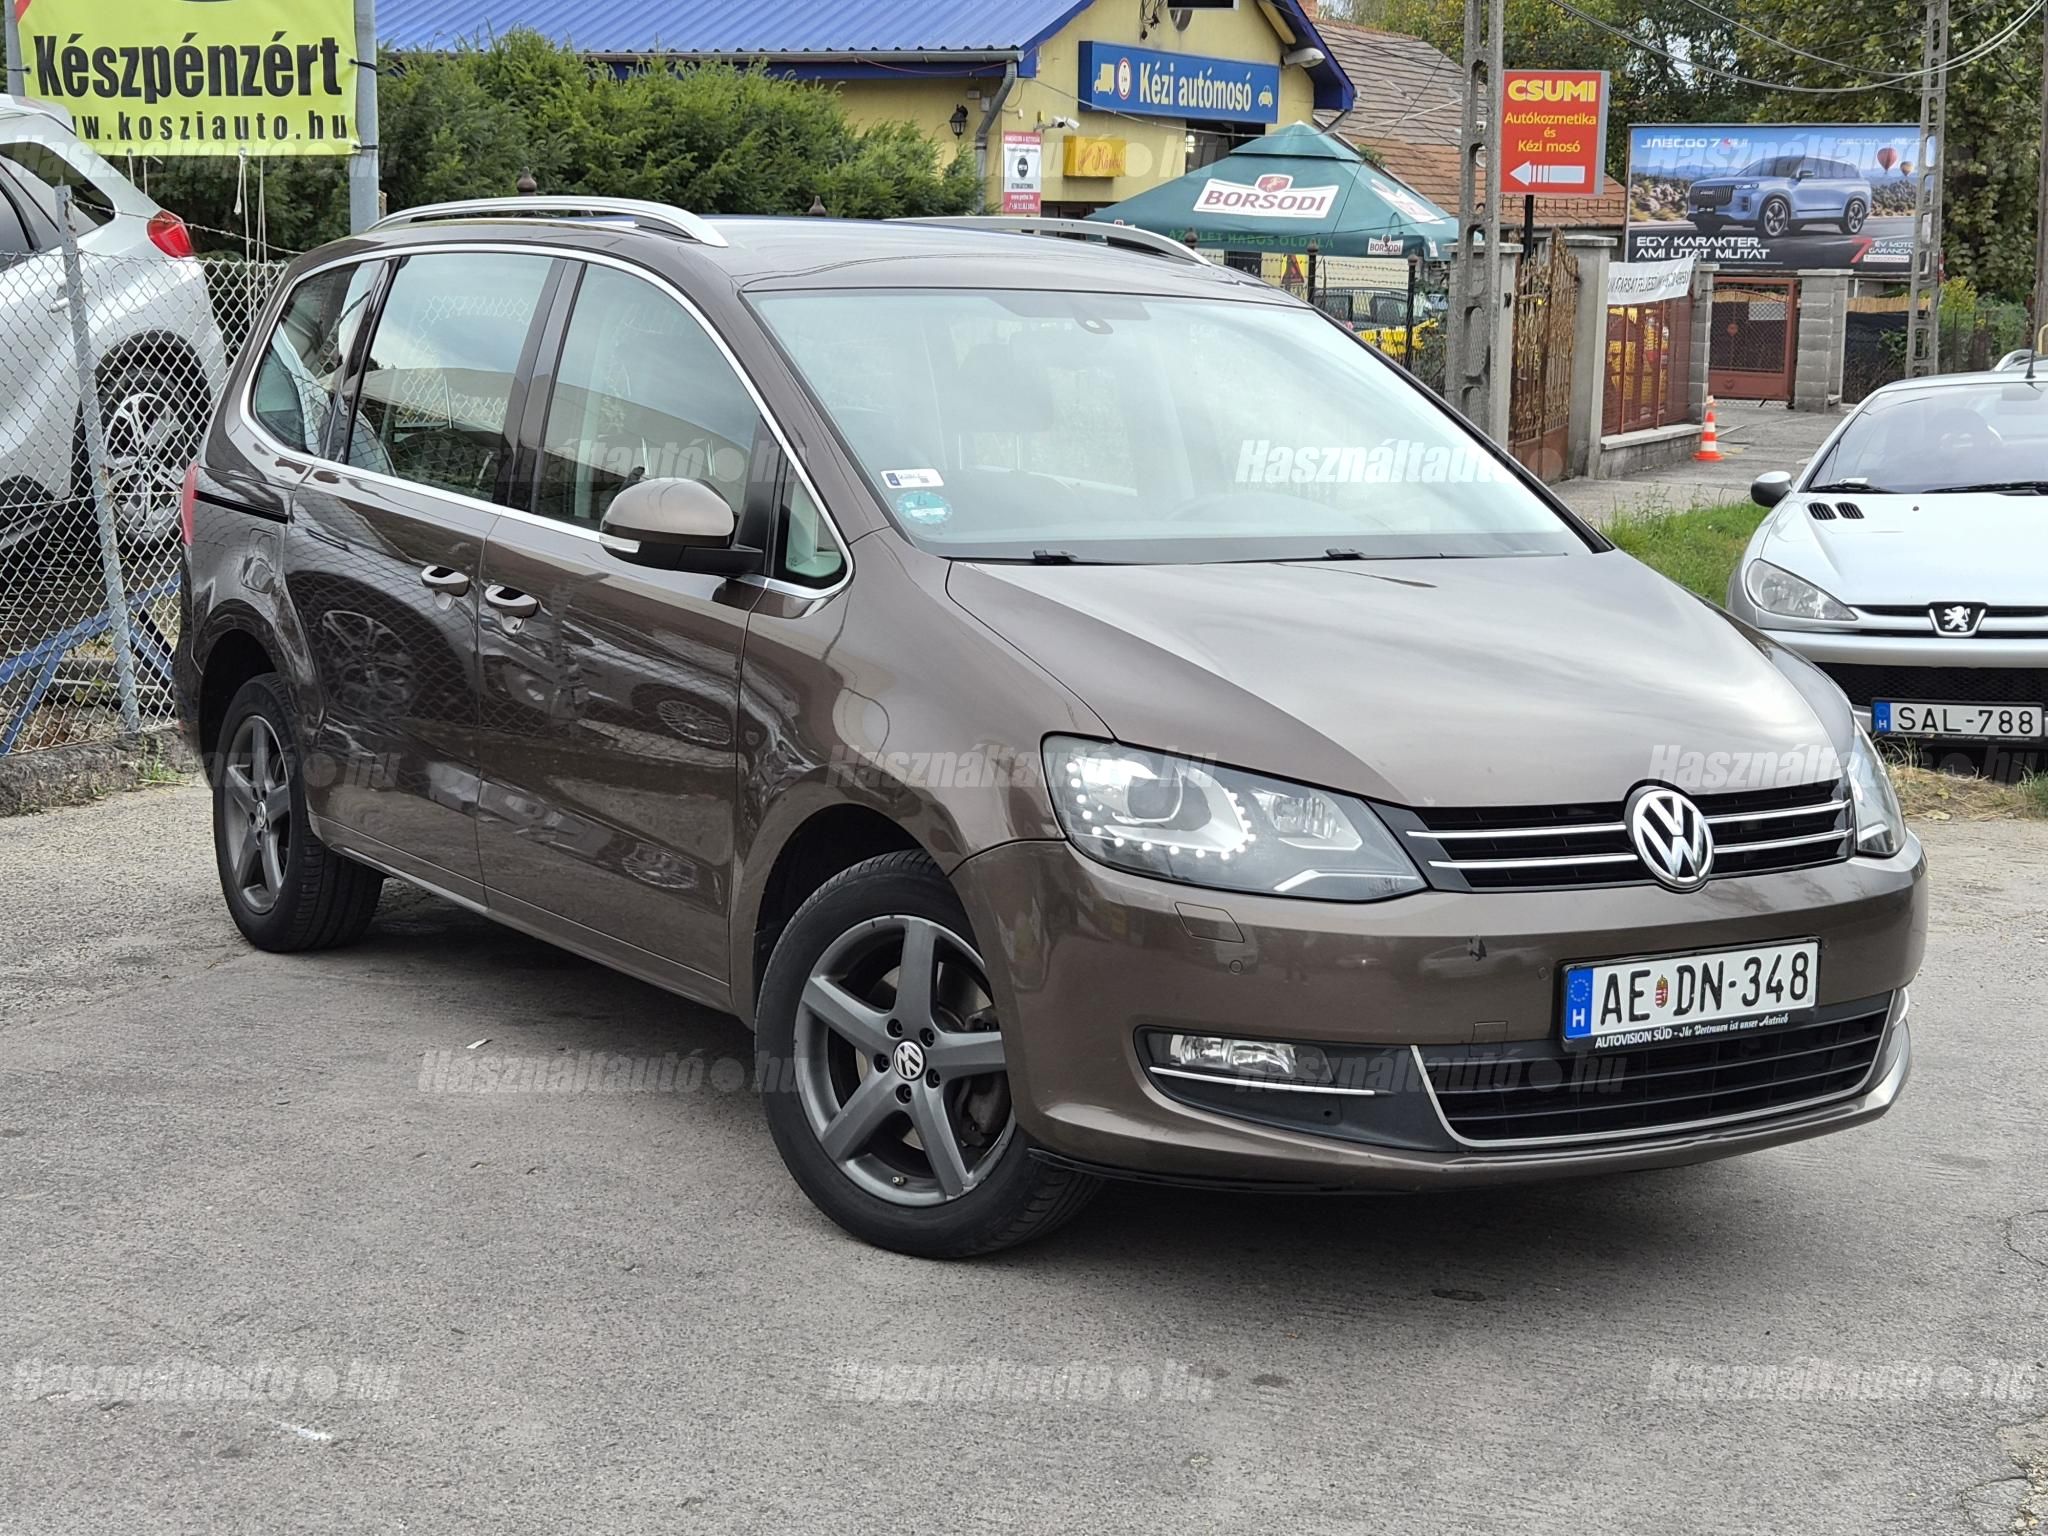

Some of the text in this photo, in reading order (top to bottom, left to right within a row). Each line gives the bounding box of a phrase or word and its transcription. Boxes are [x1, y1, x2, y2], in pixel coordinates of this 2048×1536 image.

[33, 31, 343, 104] Készpénzért
[1139, 60, 1251, 112] Kézi autómosó
[1507, 79, 1597, 102] CSUMI
[1504, 111, 1597, 125] Autókozmetika
[1543, 127, 1557, 138] és
[1518, 139, 1581, 152] Kézi mosó
[1203, 188, 1327, 212] BORSODI
[1636, 236, 1761, 248] EGY KARAKTER,
[1636, 248, 1770, 259] AMI UTAT MUTAT
[1878, 706, 2034, 735] H SAL-788
[1600, 950, 1809, 1026] AE DN-348
[1572, 1007, 1586, 1028] H
[1594, 1028, 1652, 1049] AUTOVISION
[1652, 1025, 1673, 1042] SÜD
[1729, 1020, 1738, 1032] ist
[1739, 1019, 1758, 1031] unser
